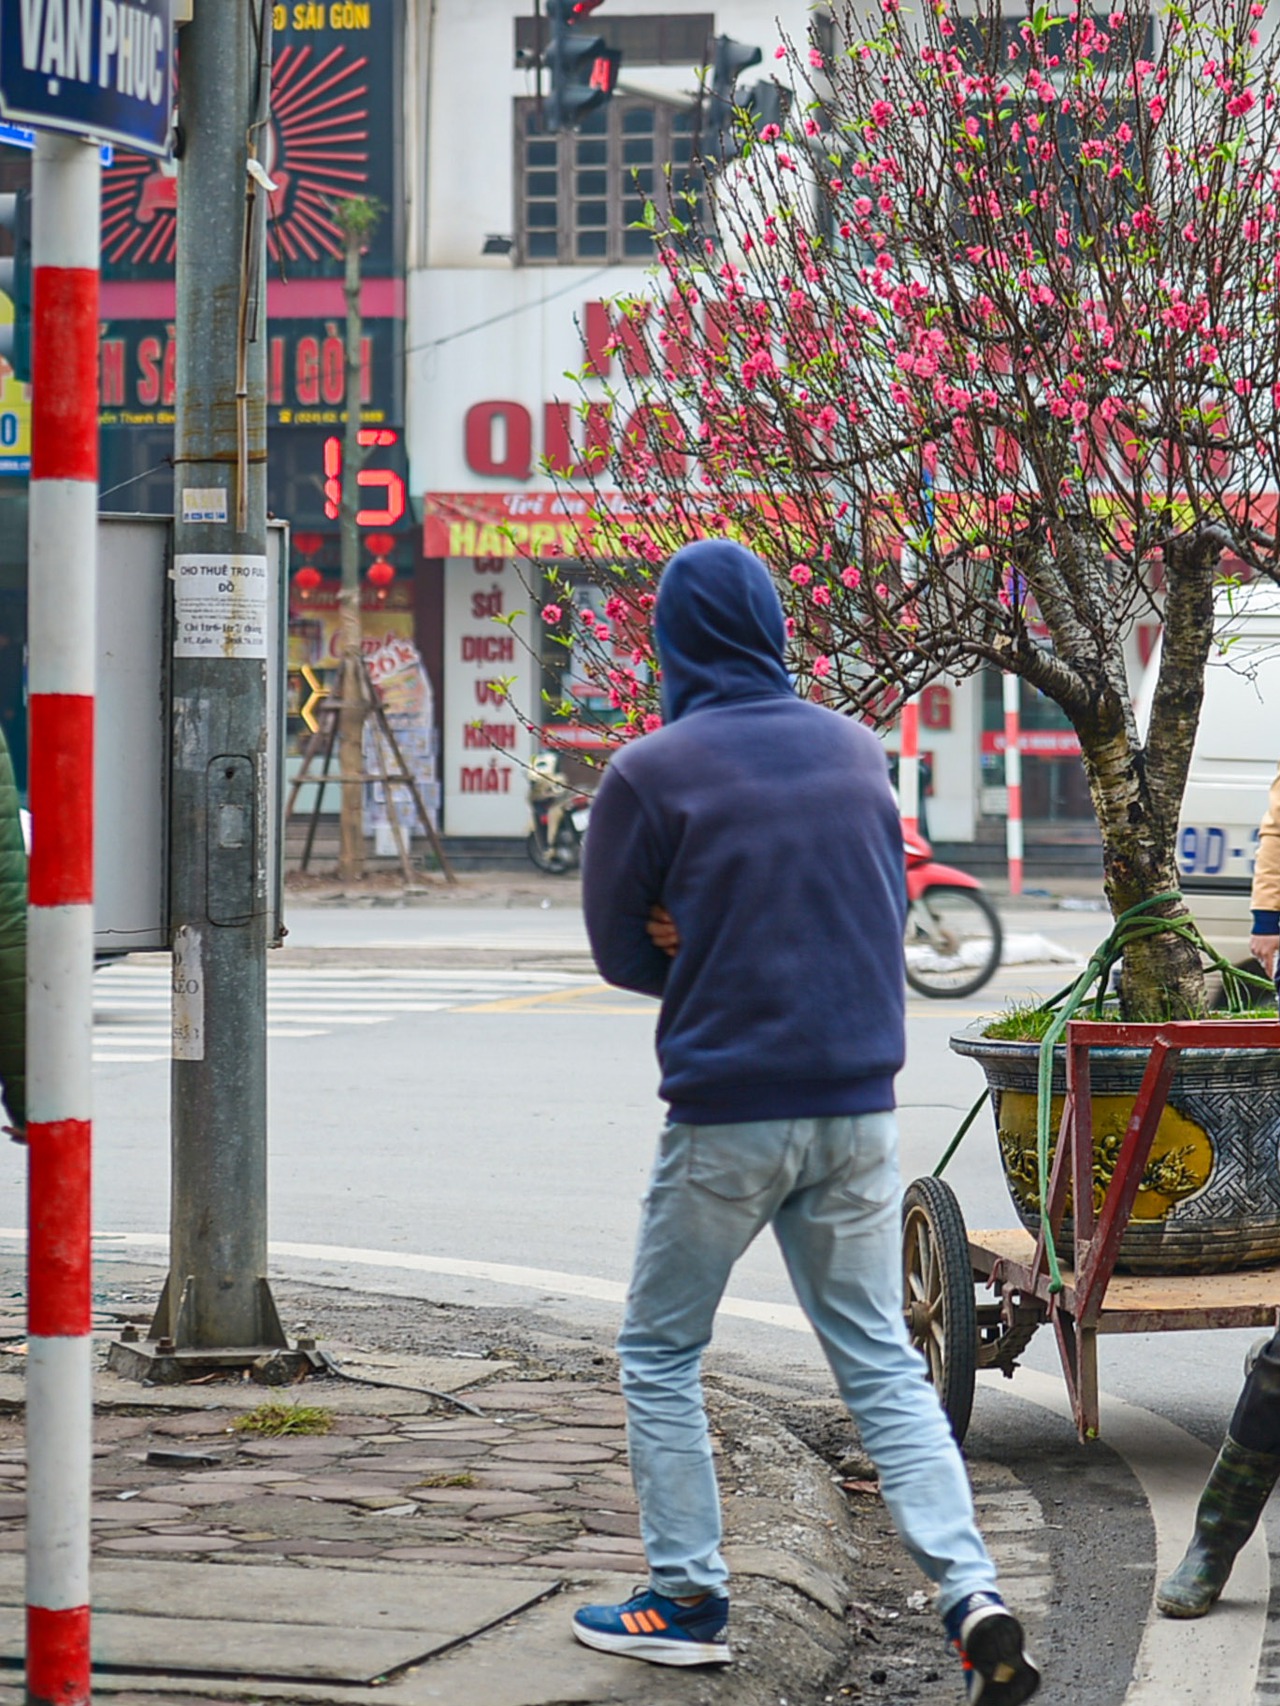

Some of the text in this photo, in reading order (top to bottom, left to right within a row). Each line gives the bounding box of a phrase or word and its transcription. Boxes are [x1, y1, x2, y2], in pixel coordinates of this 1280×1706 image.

[293, 2, 325, 30] SÀI
[330, 2, 370, 29] GÒN
[20, 0, 91, 96] VẠN
[323, 428, 406, 527] 15
[449, 521, 585, 558] HAPPY
[201, 564, 228, 576] THUÊ
[231, 567, 250, 578] TRỌ
[461, 635, 515, 668] DỊCH
